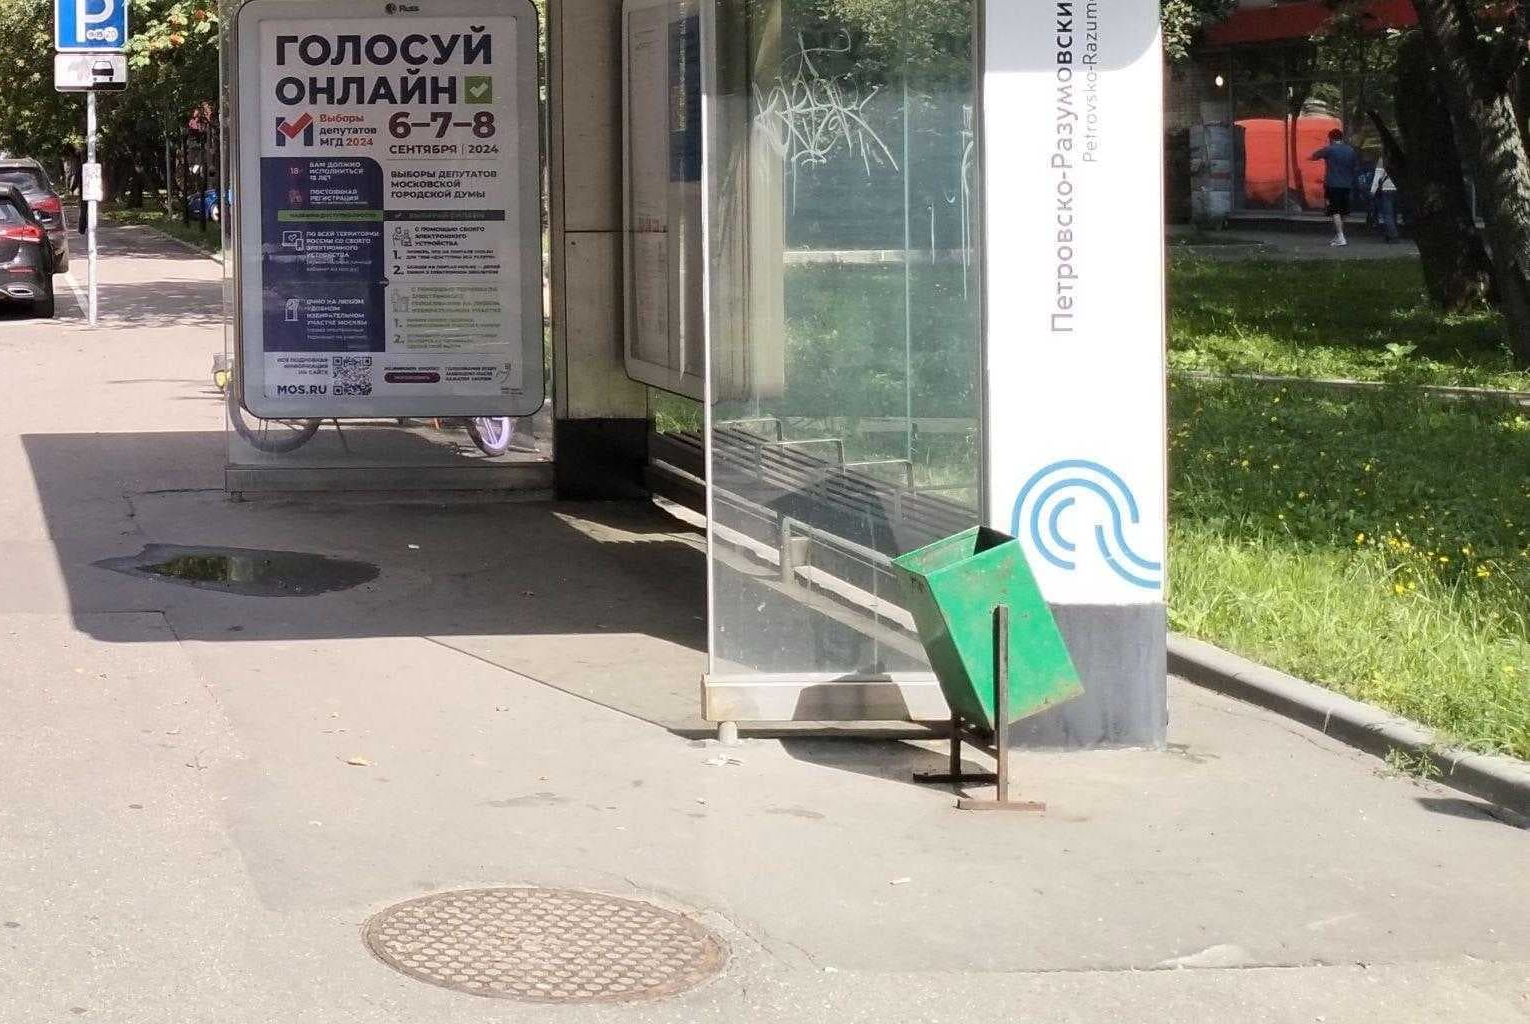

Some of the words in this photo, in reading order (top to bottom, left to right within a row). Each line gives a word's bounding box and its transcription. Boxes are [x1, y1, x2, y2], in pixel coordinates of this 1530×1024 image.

[275, 25, 492, 66] ГОЛОСУЙ
[275, 68, 457, 105] ОНЛАЙН
[319, 113, 365, 124] Выборы
[319, 126, 377, 137] депутатов
[319, 138, 344, 148] МГД
[346, 138, 374, 147] 2024
[389, 144, 457, 154] СЕНТЯБРЯ
[468, 144, 499, 154] 2024
[390, 170, 436, 178] ВЫБОРЫ
[438, 170, 497, 179] ДЕПУТАТОВ
[390, 179, 461, 188] МОСКОВСКОЙ
[390, 189, 451, 199] ГОРОДСКОЙ
[453, 190, 486, 199] ДУМЫ
[277, 384, 327, 395] MOS.RU
